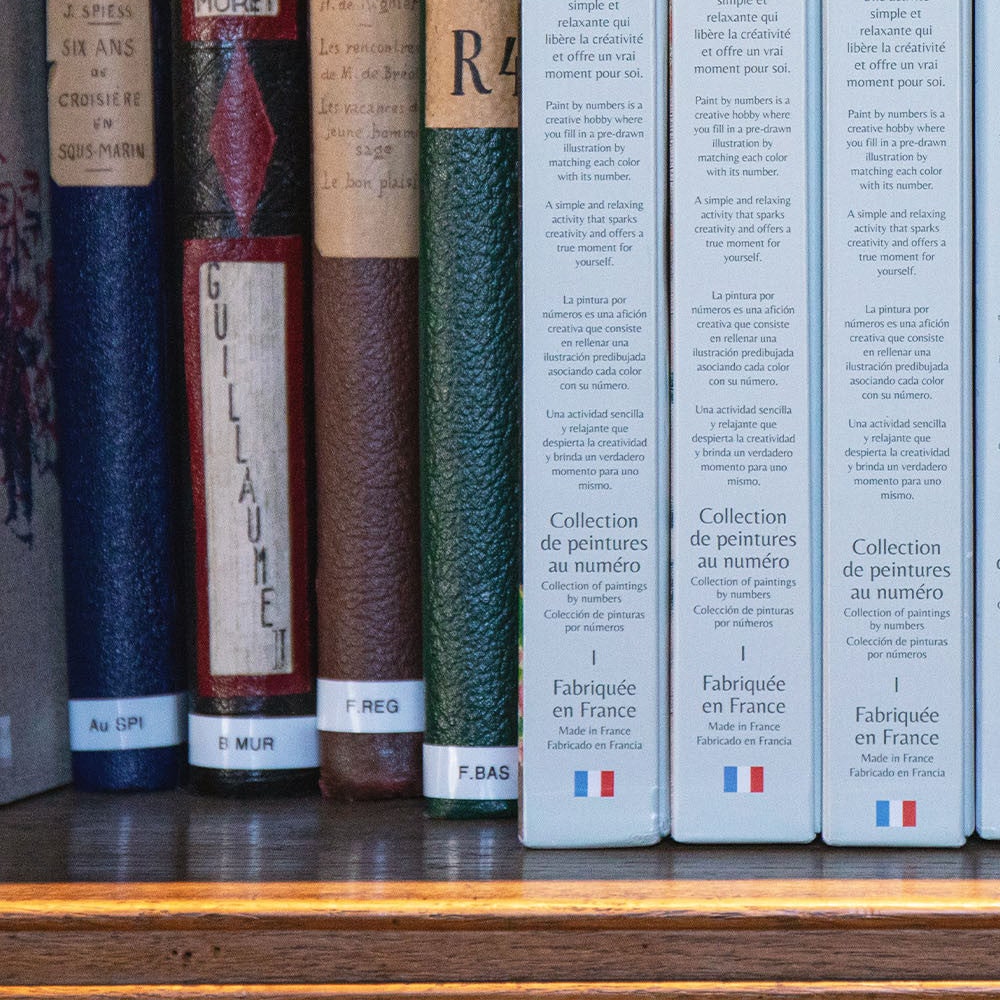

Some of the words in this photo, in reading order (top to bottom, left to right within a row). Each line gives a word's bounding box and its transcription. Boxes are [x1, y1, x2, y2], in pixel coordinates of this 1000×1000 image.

[82, 3, 134, 19] SPIESS
[62, 38, 88, 57] SIX
[95, 38, 136, 57] ANS
[450, 28, 493, 96] R
[847, 109, 872, 119] Paint
[874, 108, 886, 122] by
[887, 108, 928, 119] numbers
[930, 108, 938, 119] is
[939, 111, 946, 119] a
[369, 121, 419, 139] homm
[379, 171, 419, 198] plaisi
[206, 262, 275, 629] GUILLAUME
[549, 511, 638, 529] Collection
[703, 674, 786, 695] Fabriquée
[345, 698, 400, 714] F.REG
[702, 701, 723, 714] en
[730, 697, 786, 714] France
[89, 718, 109, 733] Au
[115, 715, 144, 732] SPI
[218, 736, 229, 751] B
[235, 736, 275, 752] MUR
[458, 764, 511, 781] F.BAS
